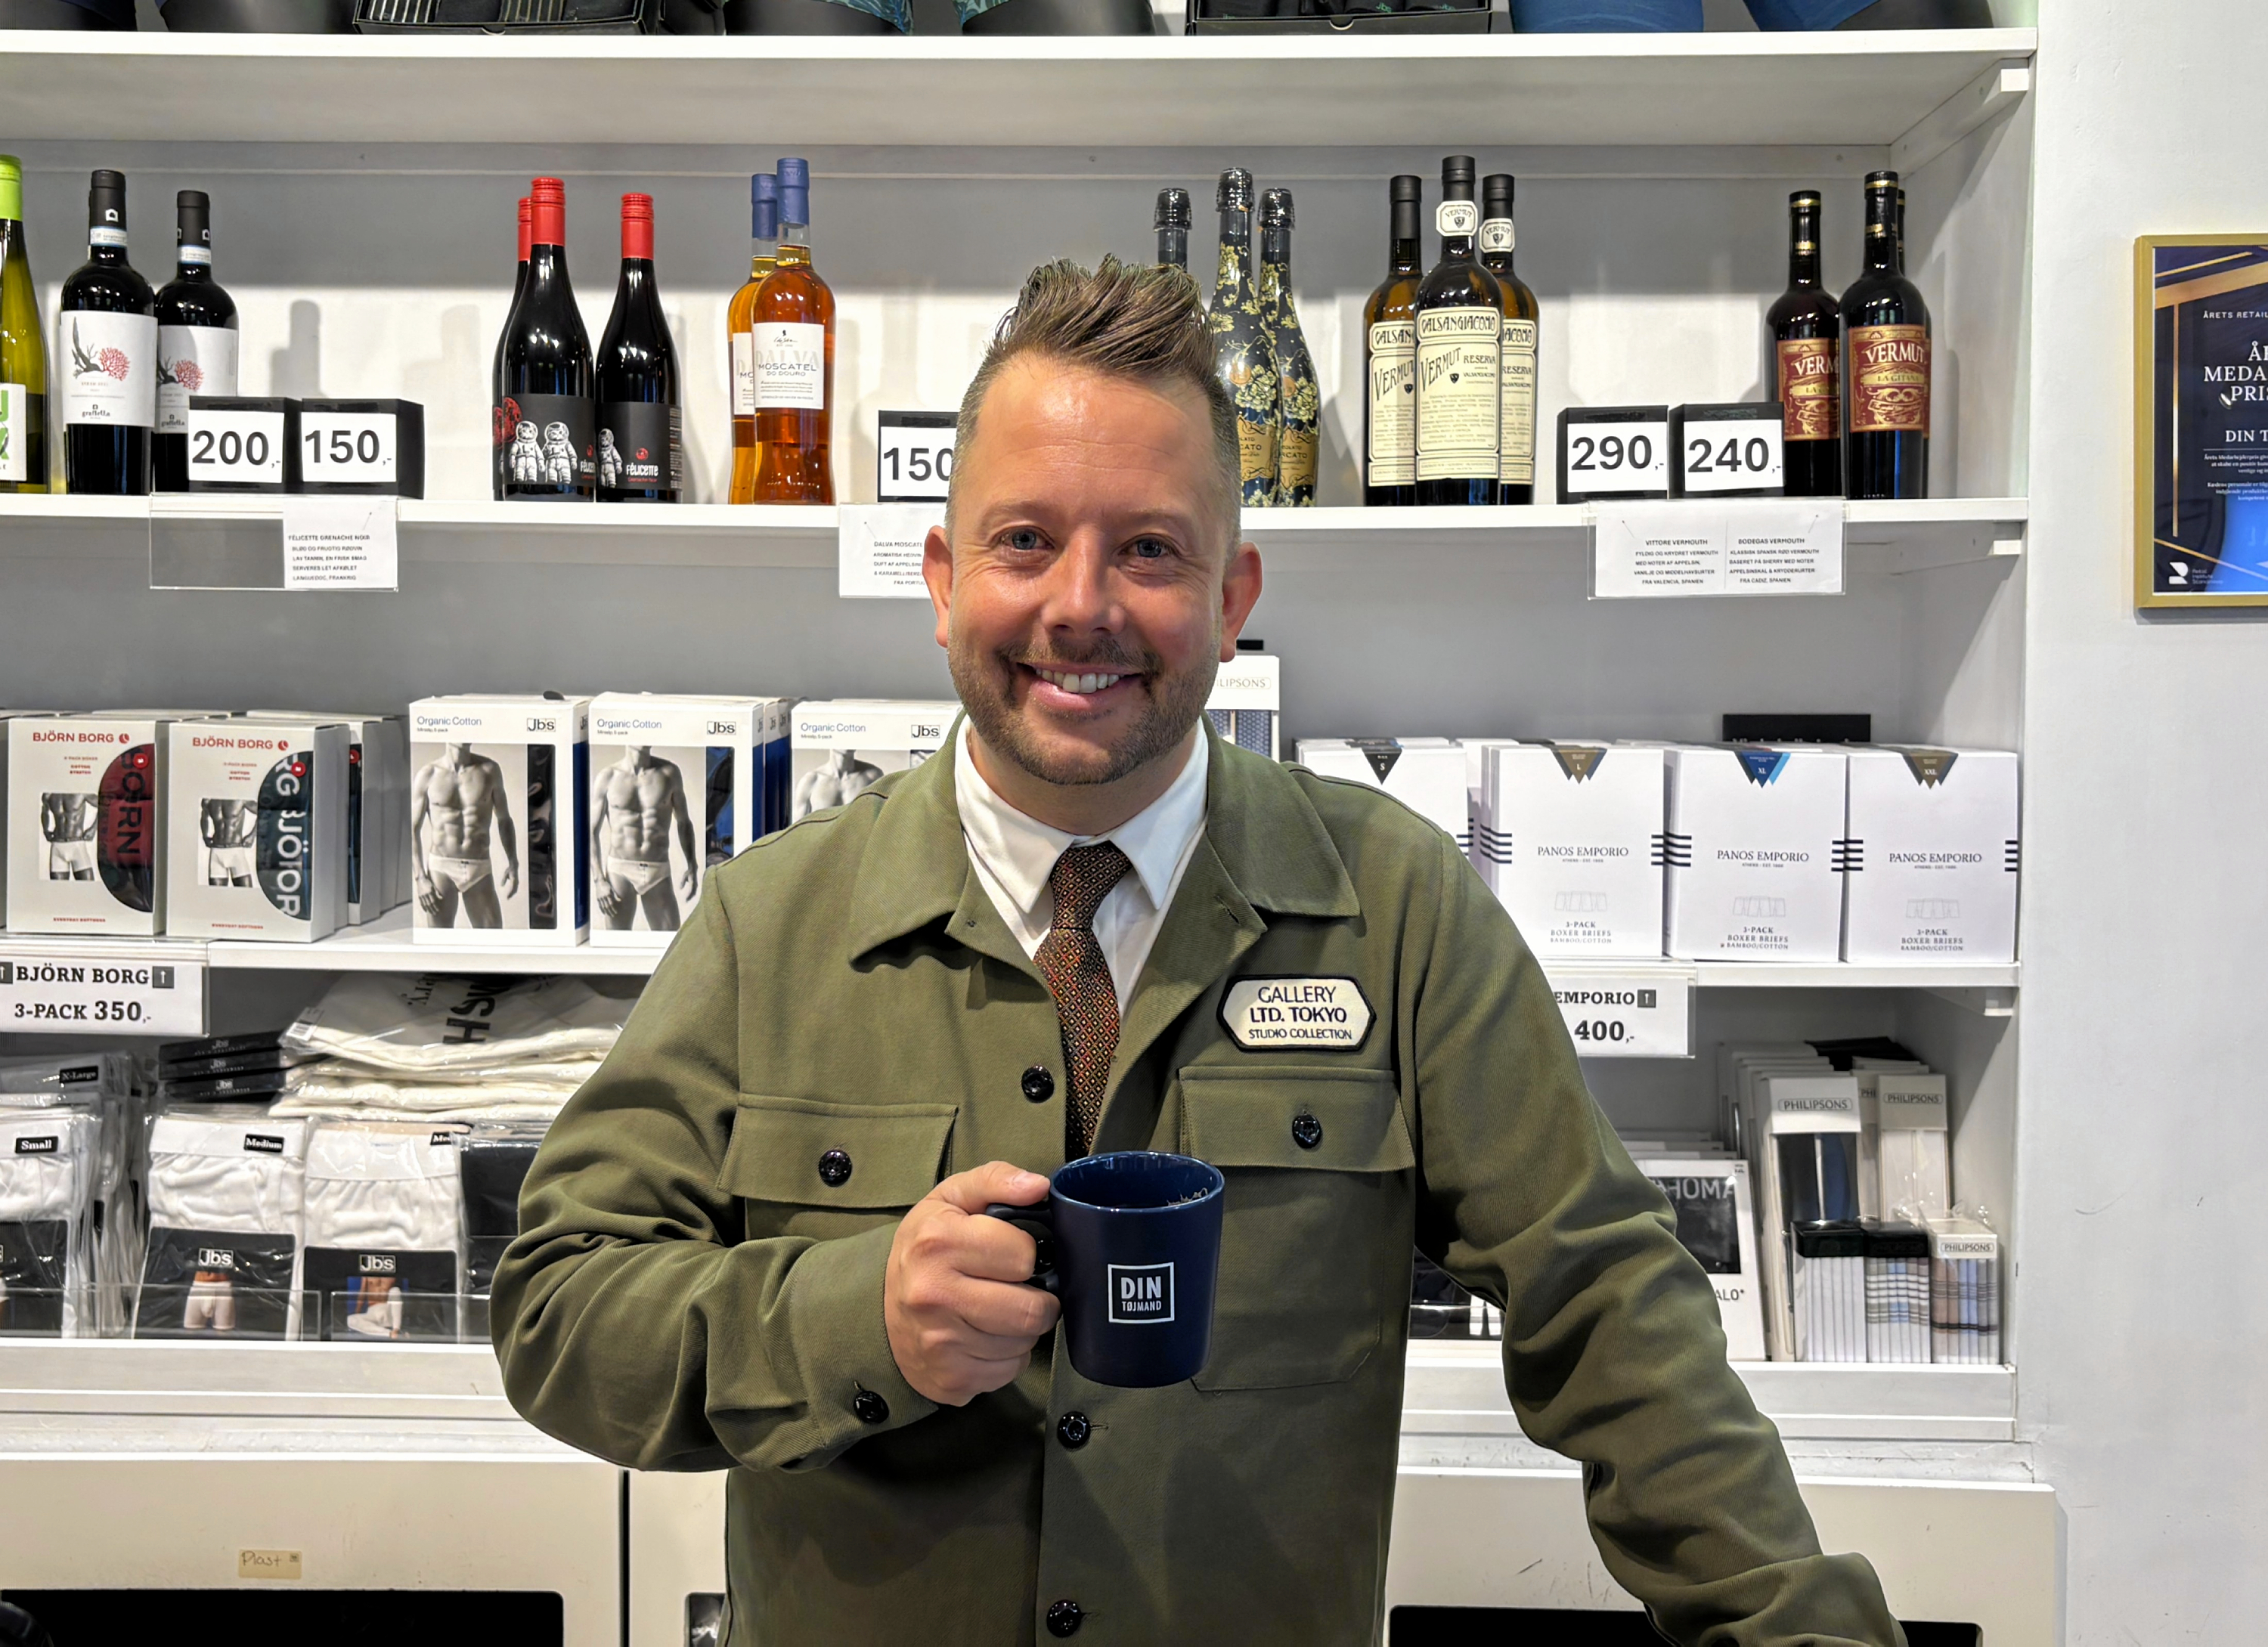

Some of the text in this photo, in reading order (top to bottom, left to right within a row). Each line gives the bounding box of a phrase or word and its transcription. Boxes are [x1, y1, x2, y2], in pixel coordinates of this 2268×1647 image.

[1445, 209, 1472, 218] VERMUT
[1485, 225, 1510, 235] VERMUT
[1865, 342, 1925, 364] VERMUT
[758, 363, 817, 371] MOSCATEL
[1421, 347, 1496, 392] VERMUT RESERVA
[1795, 355, 1836, 376] VERM
[2204, 366, 2268, 382] MEDA
[2231, 385, 2268, 401] PRI
[2226, 430, 2254, 442] DIN
[417, 717, 482, 726] Organic Cotton
[527, 718, 555, 732] Jbs
[596, 718, 662, 729] Organic Cotton
[708, 721, 736, 735] Jbs
[801, 723, 866, 733] Organic Cotton
[911, 725, 940, 738] Jbs
[33, 730, 114, 742] BJÖRN BORG
[192, 735, 273, 749] BJÖRN BORG
[1380, 763, 1385, 771] S
[1538, 847, 1629, 856] PANOS EMPORIO
[1717, 850, 1809, 862] PANOS EMPORIO
[1889, 853, 1982, 862] PANOS EMPORIO
[17, 963, 150, 984] BJÖRN BORG
[1258, 986, 1336, 1003] GALLERY
[1554, 991, 1635, 1005] EMPORIO
[14, 1003, 87, 1020] 3-PACK
[1250, 1007, 1347, 1023] LTD. TOKYO
[1248, 1029, 1352, 1039] STUDIO COLLECTION
[62, 1071, 96, 1080] X-Large
[1784, 1100, 1848, 1110] PHILIPSONS
[1888, 1094, 1940, 1104] PHILIPSONS
[21, 1139, 52, 1150] Small
[246, 1137, 283, 1150] Medium
[1944, 1243, 1991, 1252] PHILIPSONS
[200, 1249, 233, 1267] Jbs
[359, 1255, 395, 1272] Jbs
[1121, 1276, 1161, 1299] DIN
[1121, 1300, 1162, 1311] TØJMAND
[241, 1550, 282, 1567] Plast
